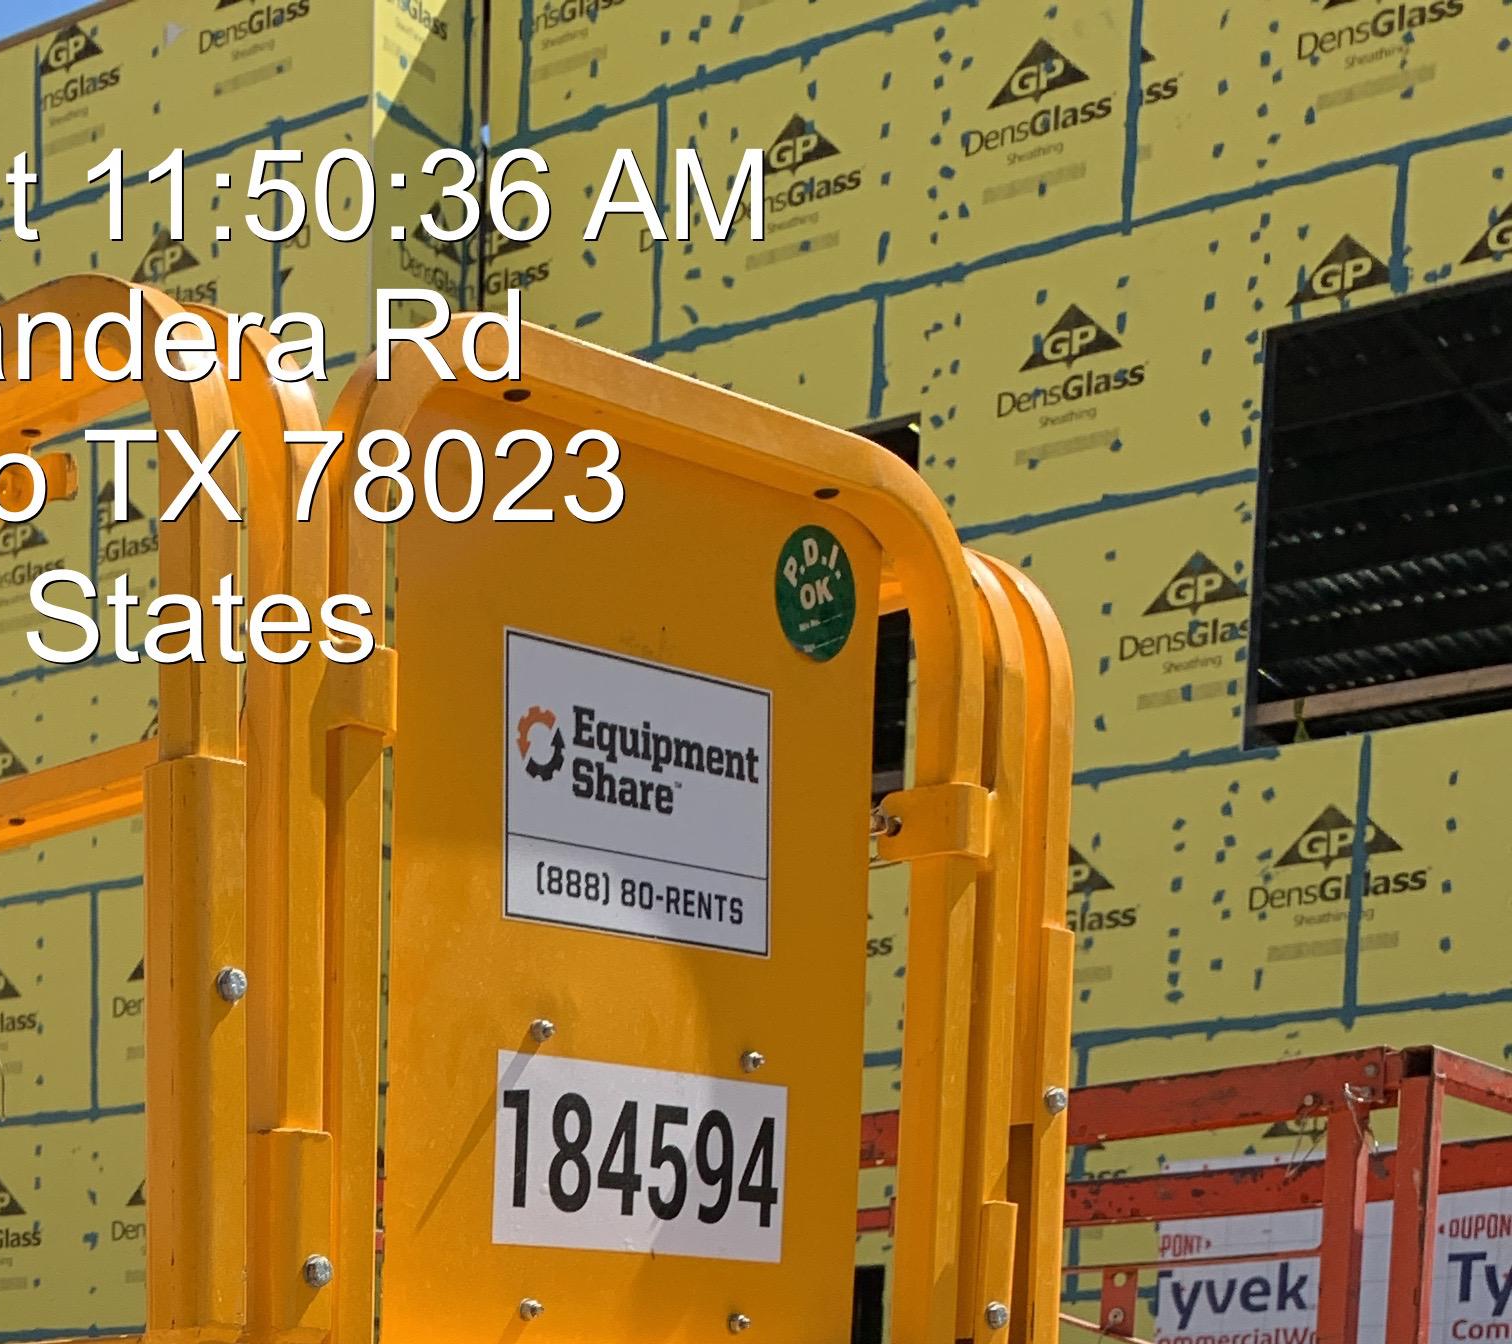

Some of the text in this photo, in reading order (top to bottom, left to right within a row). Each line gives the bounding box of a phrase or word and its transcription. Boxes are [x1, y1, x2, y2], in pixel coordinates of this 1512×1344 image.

[1297, 0, 1464, 62] DensGlass
[48, 33, 88, 67] GP
[1010, 58, 1065, 96] GP
[964, 97, 1113, 158] DensGlass
[769, 132, 819, 168] GP
[1006, 141, 1065, 166] Sheathing
[143, 247, 185, 281] GP
[1313, 257, 1373, 294] GP
[1043, 325, 1097, 361] GP
[996, 362, 1146, 419] DensGlass
[799, 576, 834, 610] OK
[1167, 573, 1222, 608] GP
[1162, 654, 1223, 675] Sheathing
[572, 705, 760, 785] Equipment
[572, 759, 675, 816] Share
[536, 860, 745, 926] (888) 80-RENTS
[502, 1088, 779, 1229] 184594
